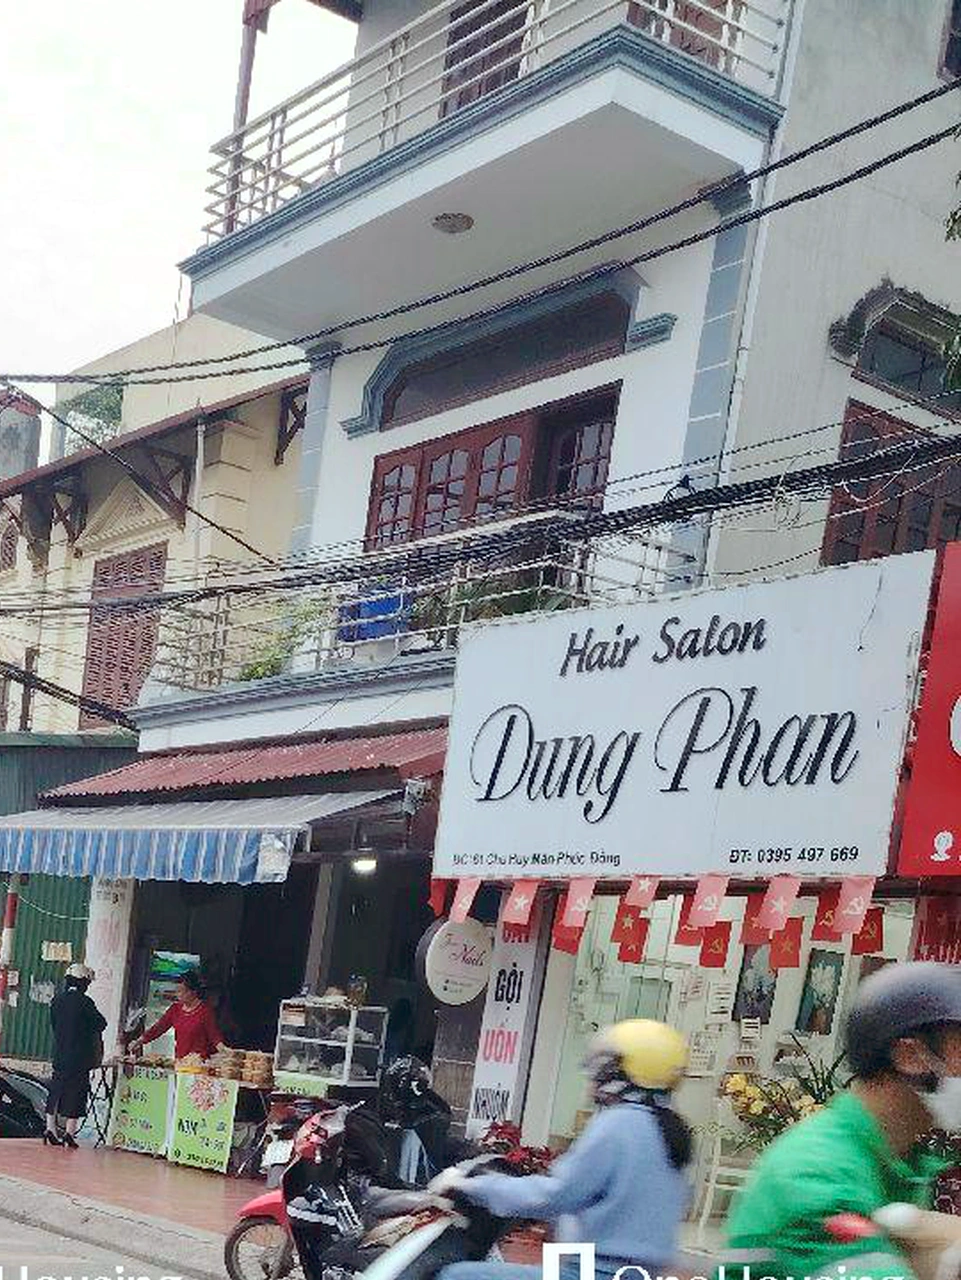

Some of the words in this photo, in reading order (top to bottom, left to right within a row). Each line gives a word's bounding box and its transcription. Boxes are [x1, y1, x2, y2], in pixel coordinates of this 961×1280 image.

[559, 624, 639, 676] Hair
[652, 615, 766, 663] Salon
[470, 704, 642, 824] Dung
[654, 686, 859, 792] Phan
[757, 847, 792, 863] 0395
[797, 847, 825, 862] 497
[829, 846, 860, 862] 669
[494, 961, 524, 1011] GỘI
